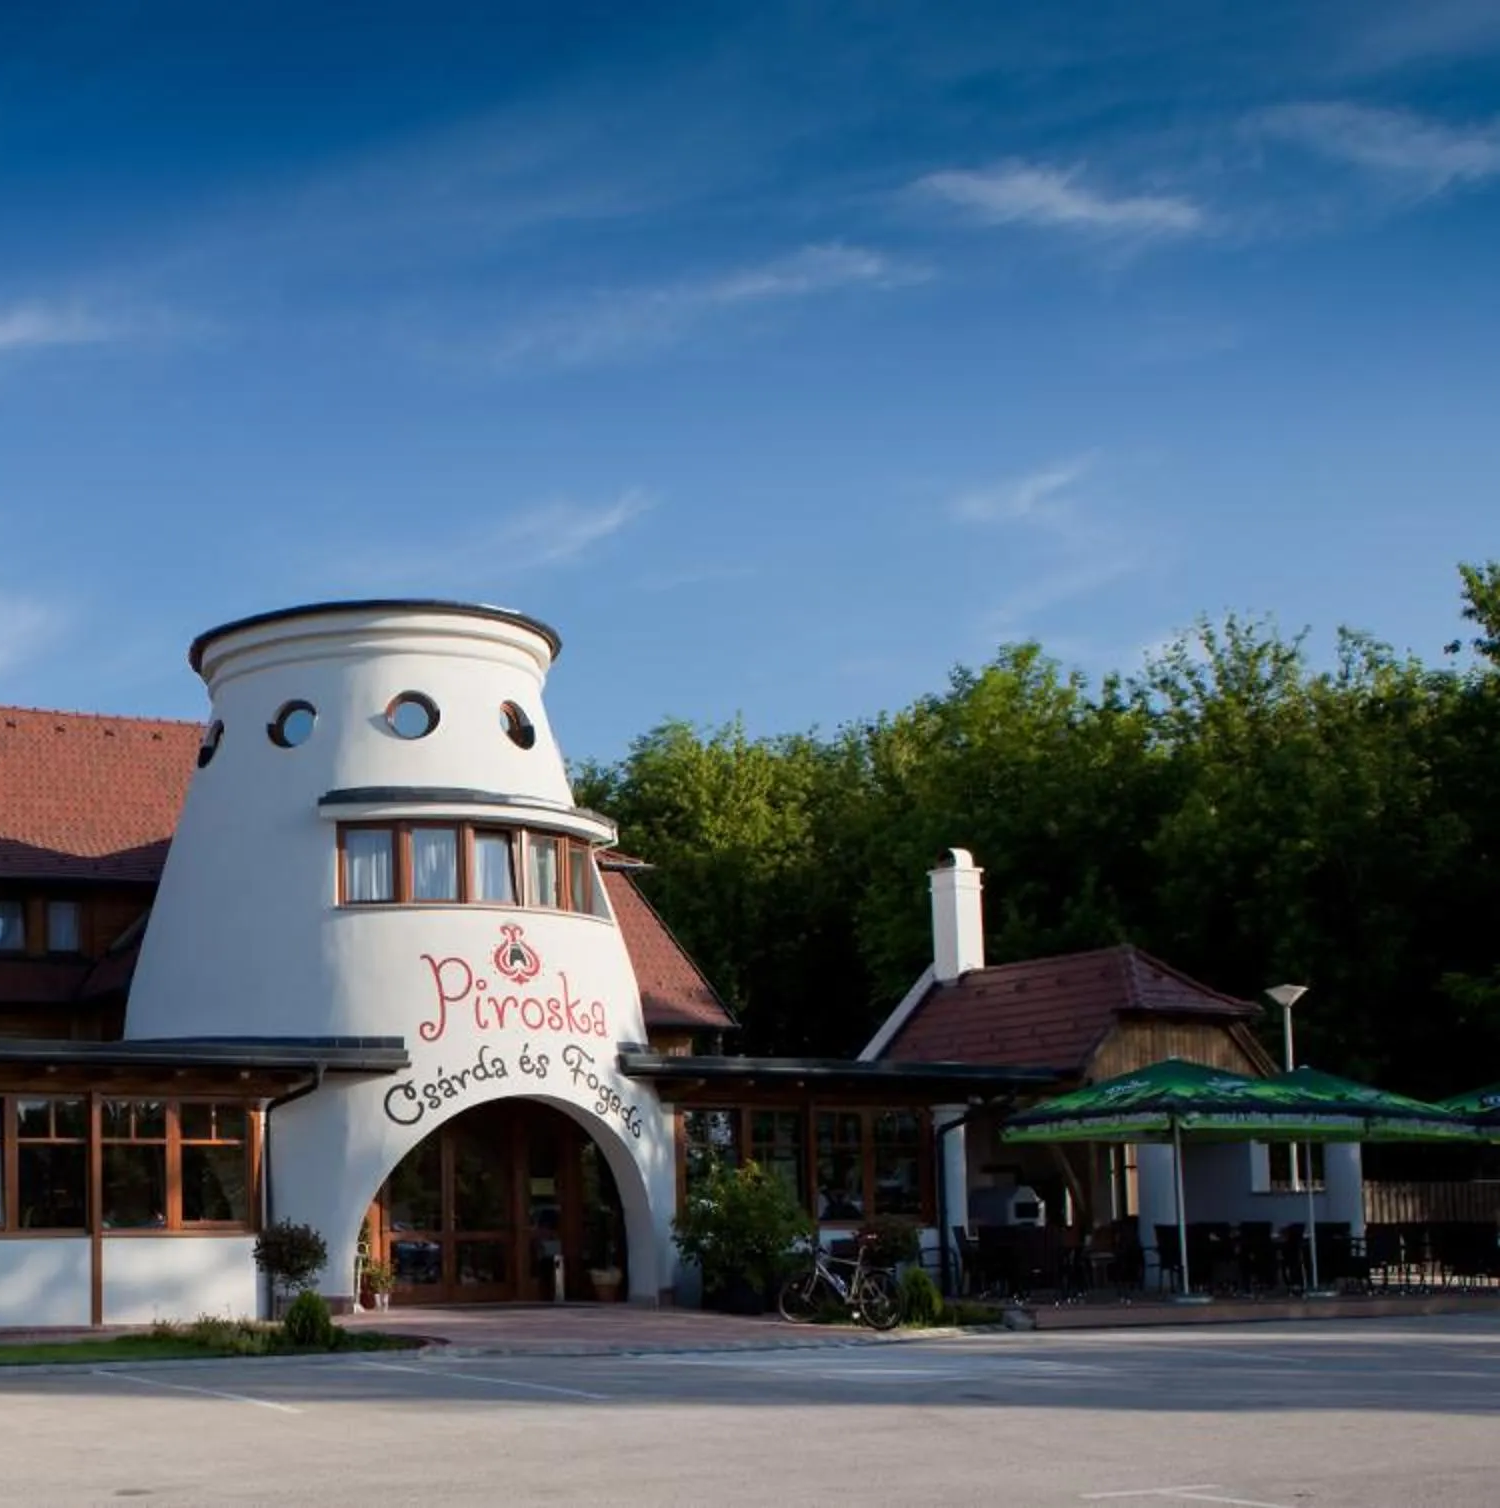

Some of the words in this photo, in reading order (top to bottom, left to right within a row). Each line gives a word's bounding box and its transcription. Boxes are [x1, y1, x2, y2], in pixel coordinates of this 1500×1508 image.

[419, 954, 608, 1042] Piroska
[383, 1045, 509, 1126] Csárda
[518, 1043, 550, 1079] és
[562, 1044, 643, 1139] Fogadó
